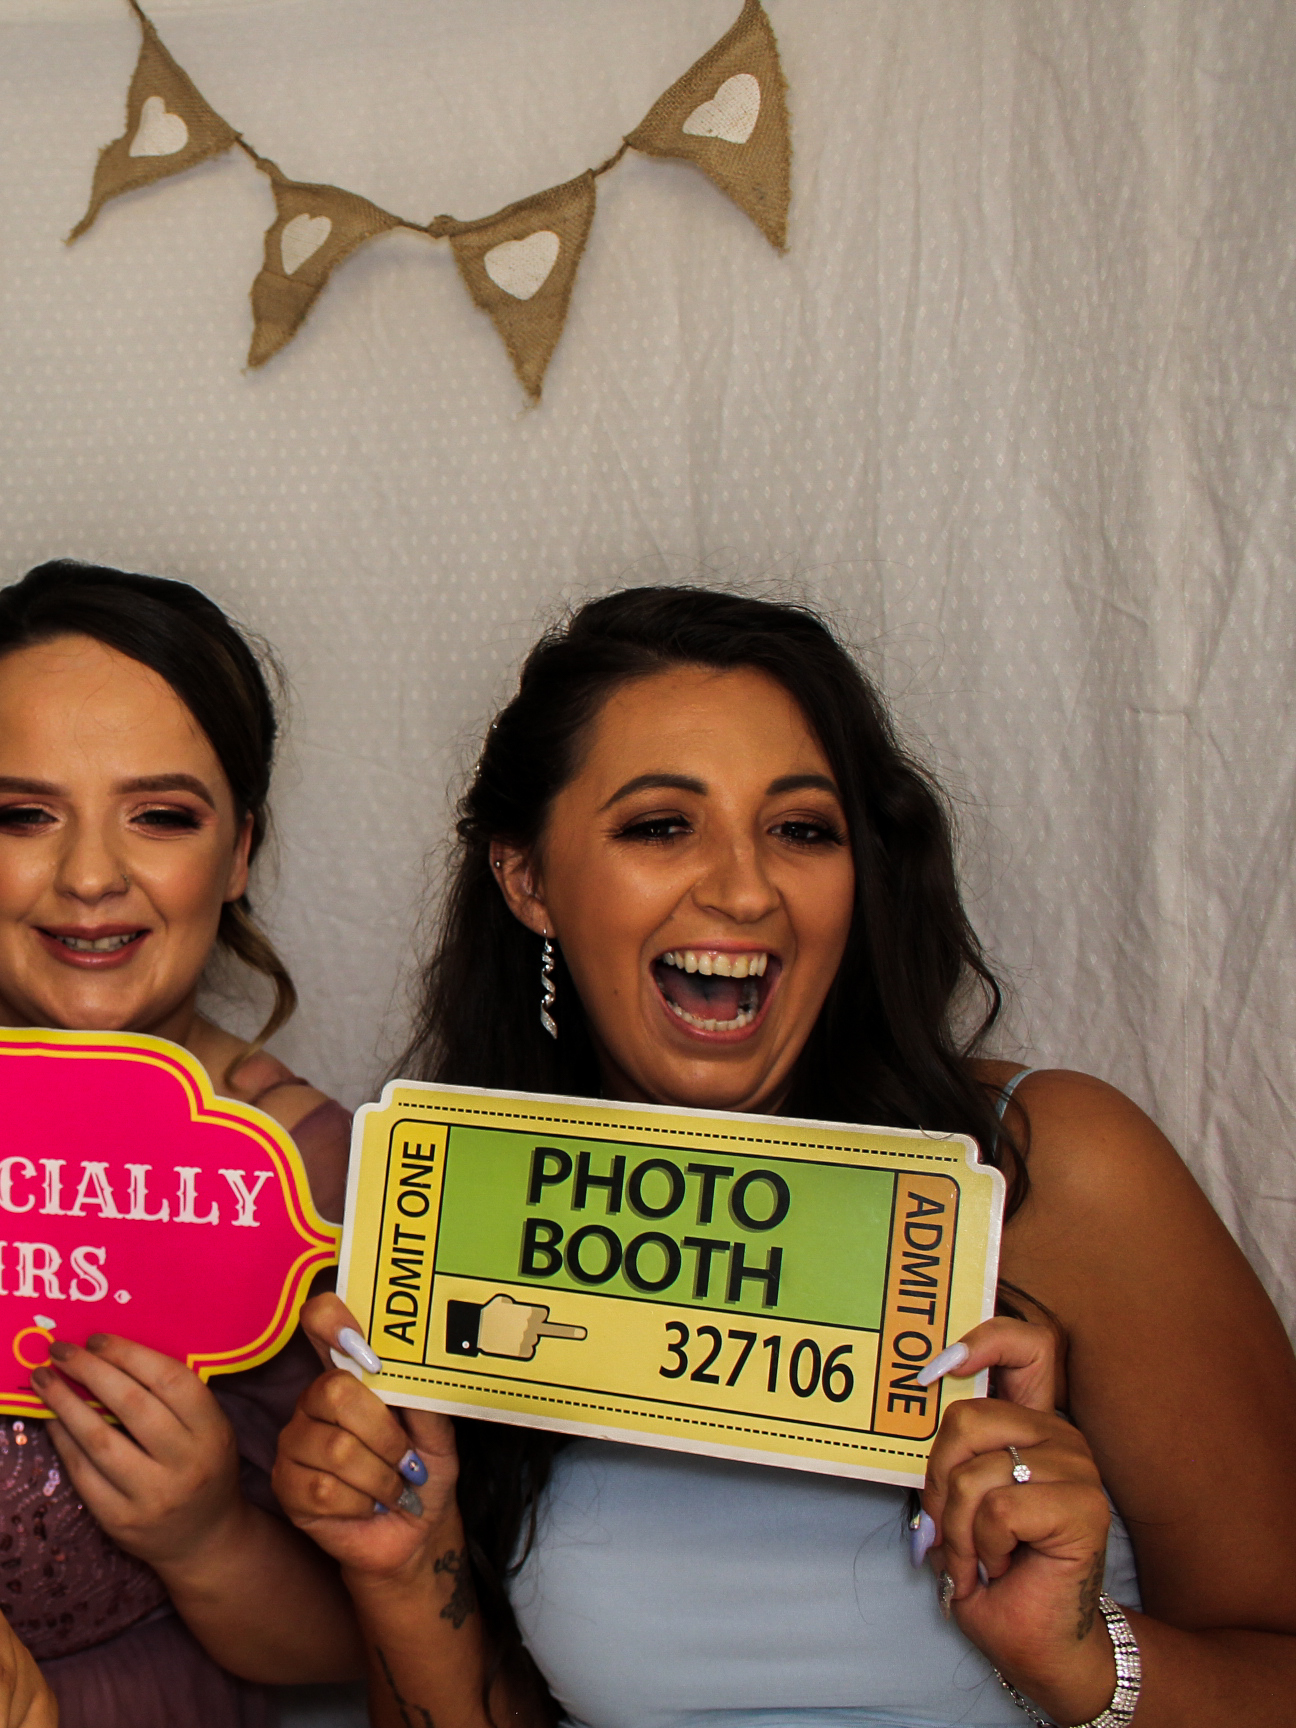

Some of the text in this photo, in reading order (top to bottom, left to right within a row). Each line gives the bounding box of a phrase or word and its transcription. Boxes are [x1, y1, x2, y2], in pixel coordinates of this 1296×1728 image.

[526, 1146, 791, 1232] PHOTO
[383, 1141, 436, 1346] ADMIT ONE
[520, 1217, 783, 1307] BOOTH
[886, 1190, 946, 1417] ADMIT ONE
[658, 1320, 855, 1402] 327106
